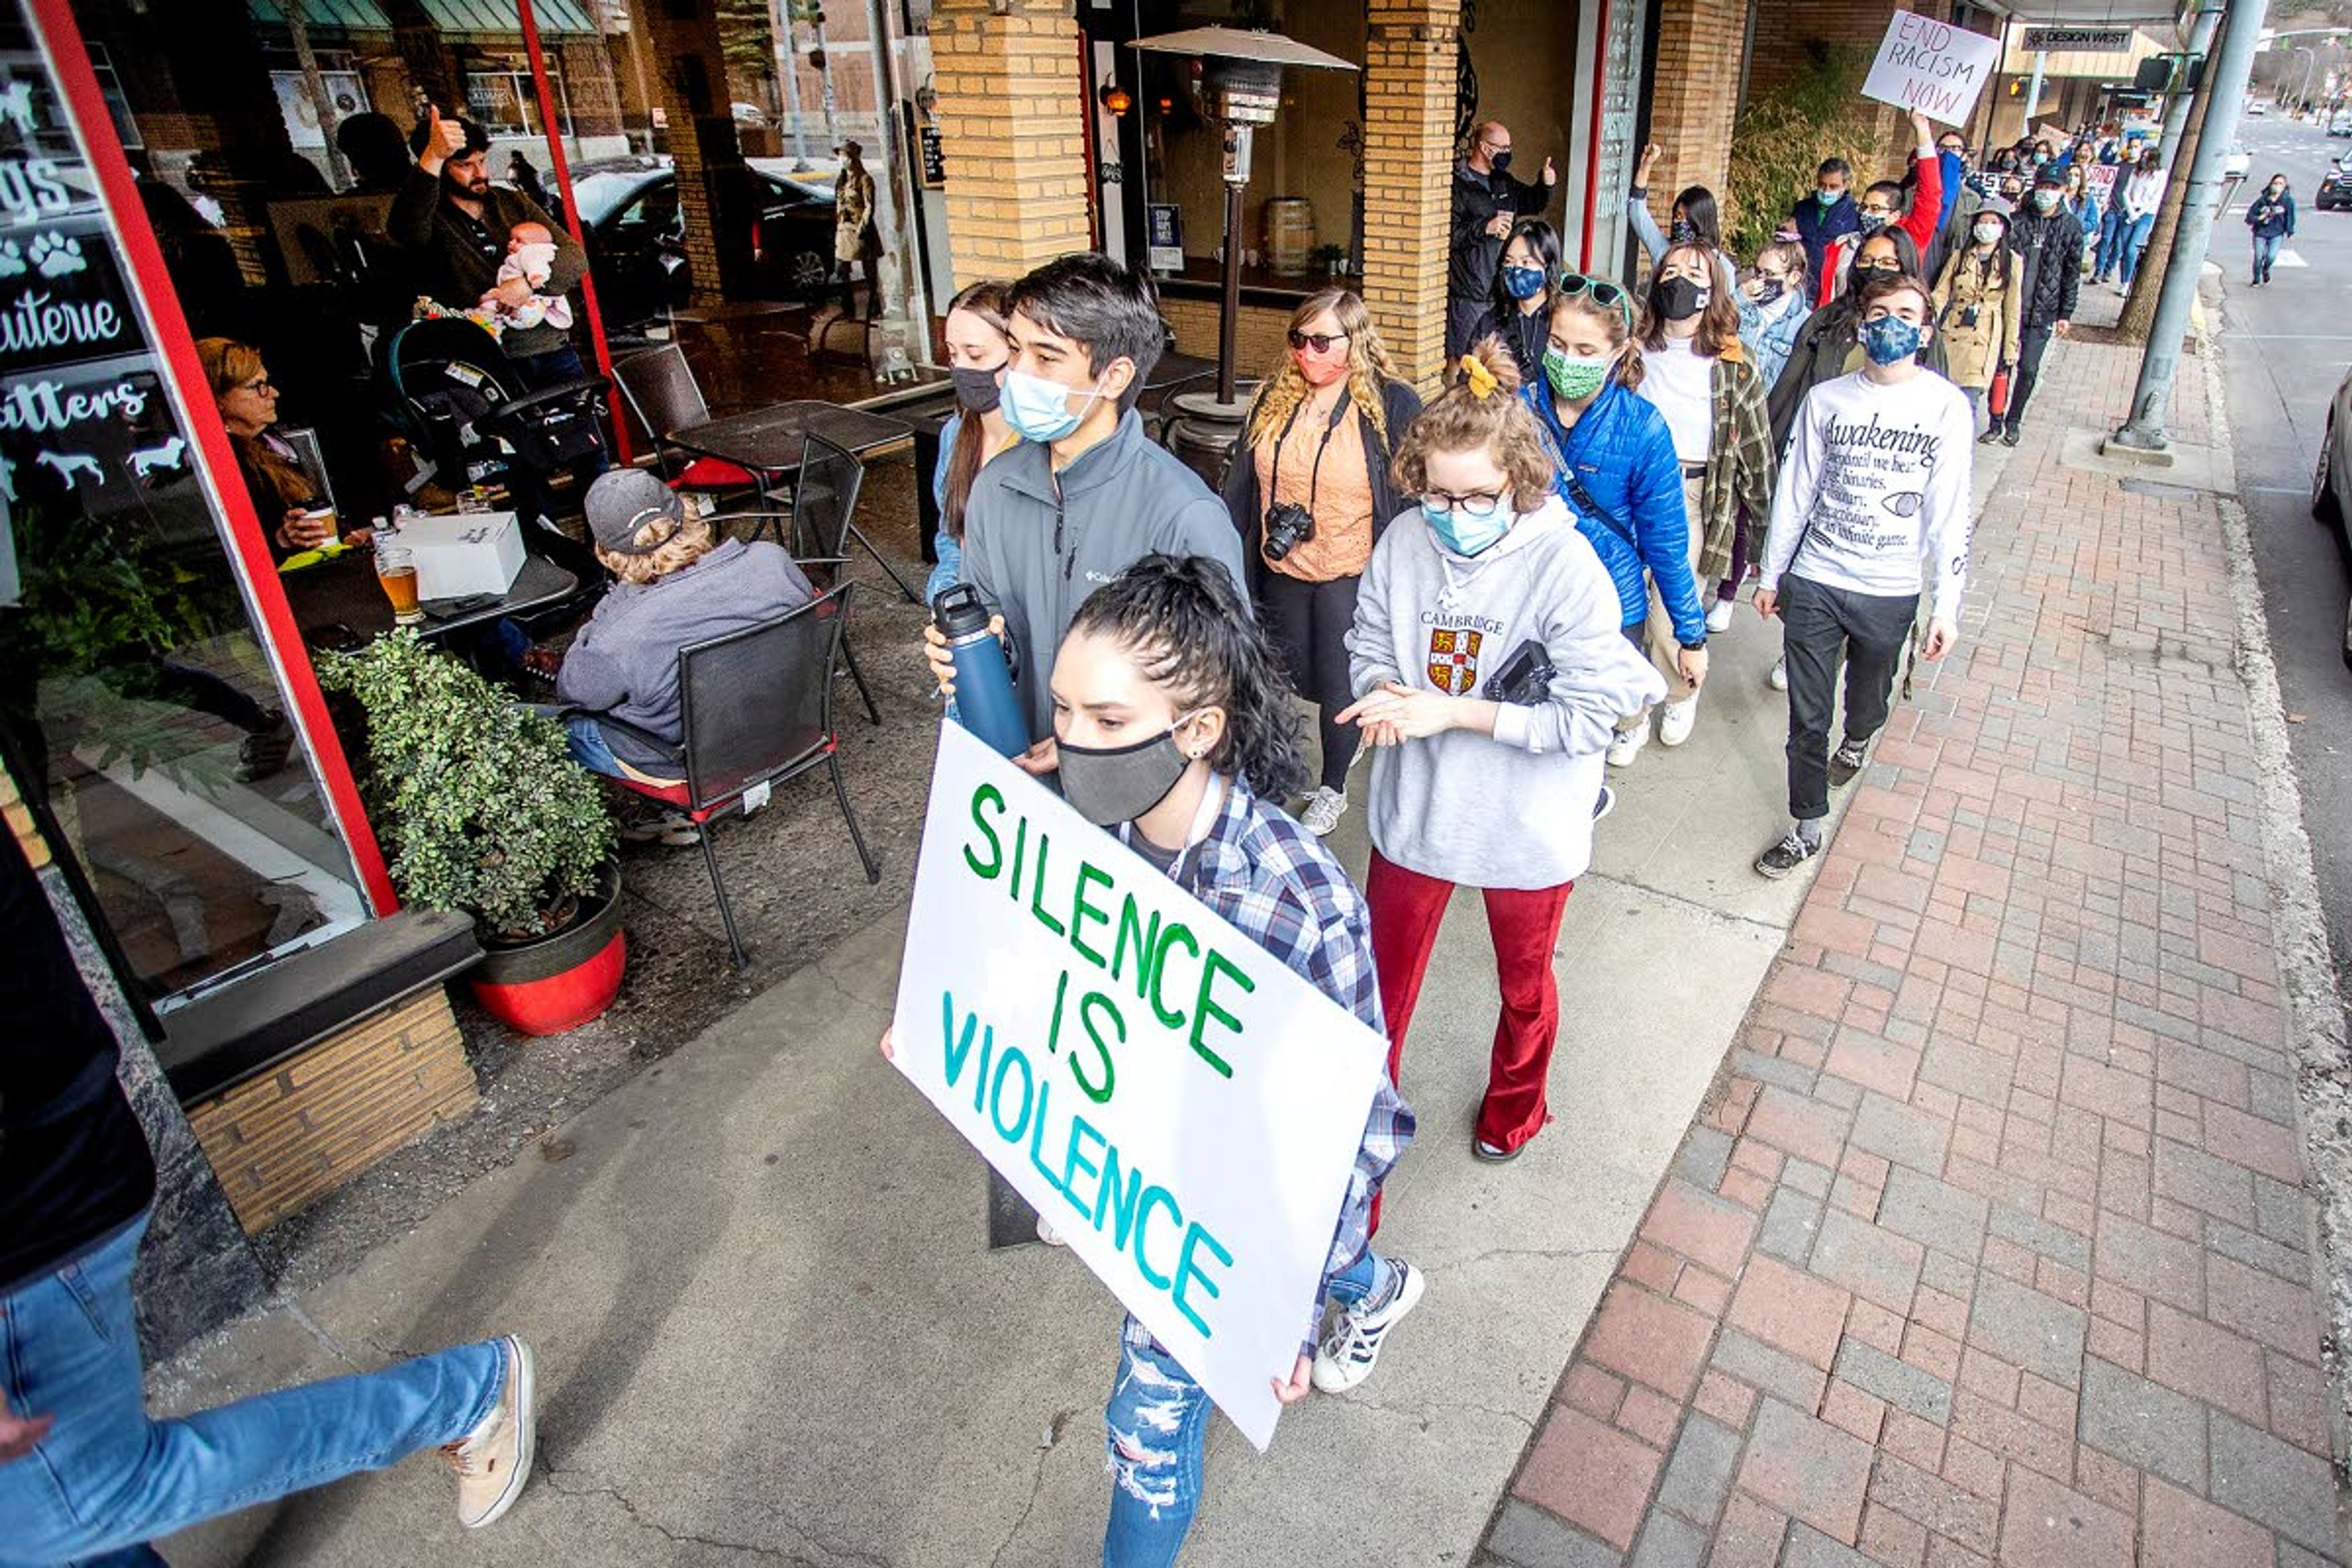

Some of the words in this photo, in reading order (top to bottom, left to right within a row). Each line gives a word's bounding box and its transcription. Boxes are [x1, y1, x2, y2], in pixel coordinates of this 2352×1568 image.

[1899, 14, 1951, 52] END
[2046, 32, 2089, 42] DESIGN
[2090, 32, 2127, 43] WEST
[1887, 42, 1975, 84] RACISM
[1901, 78, 1962, 115] NOW
[963, 783, 1254, 1079] SILENCE
[1048, 973, 1126, 1105] IS
[942, 990, 1234, 1339] VIOLENCE
